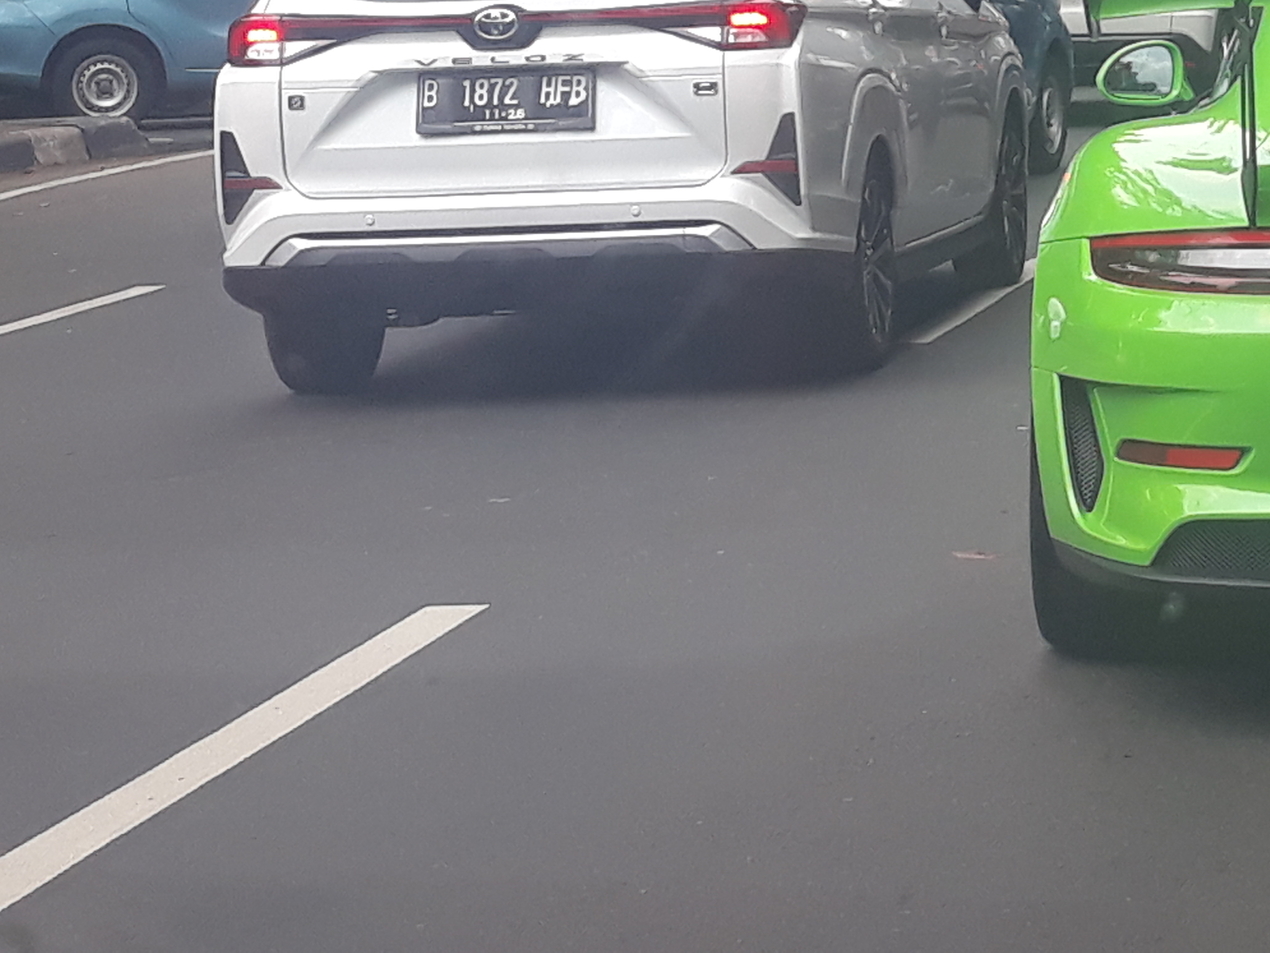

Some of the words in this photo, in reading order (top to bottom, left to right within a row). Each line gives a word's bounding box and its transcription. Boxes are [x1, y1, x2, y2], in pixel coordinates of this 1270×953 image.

[423, 80, 438, 107] B
[462, 77, 519, 108] 1872
[539, 75, 587, 108] HFB
